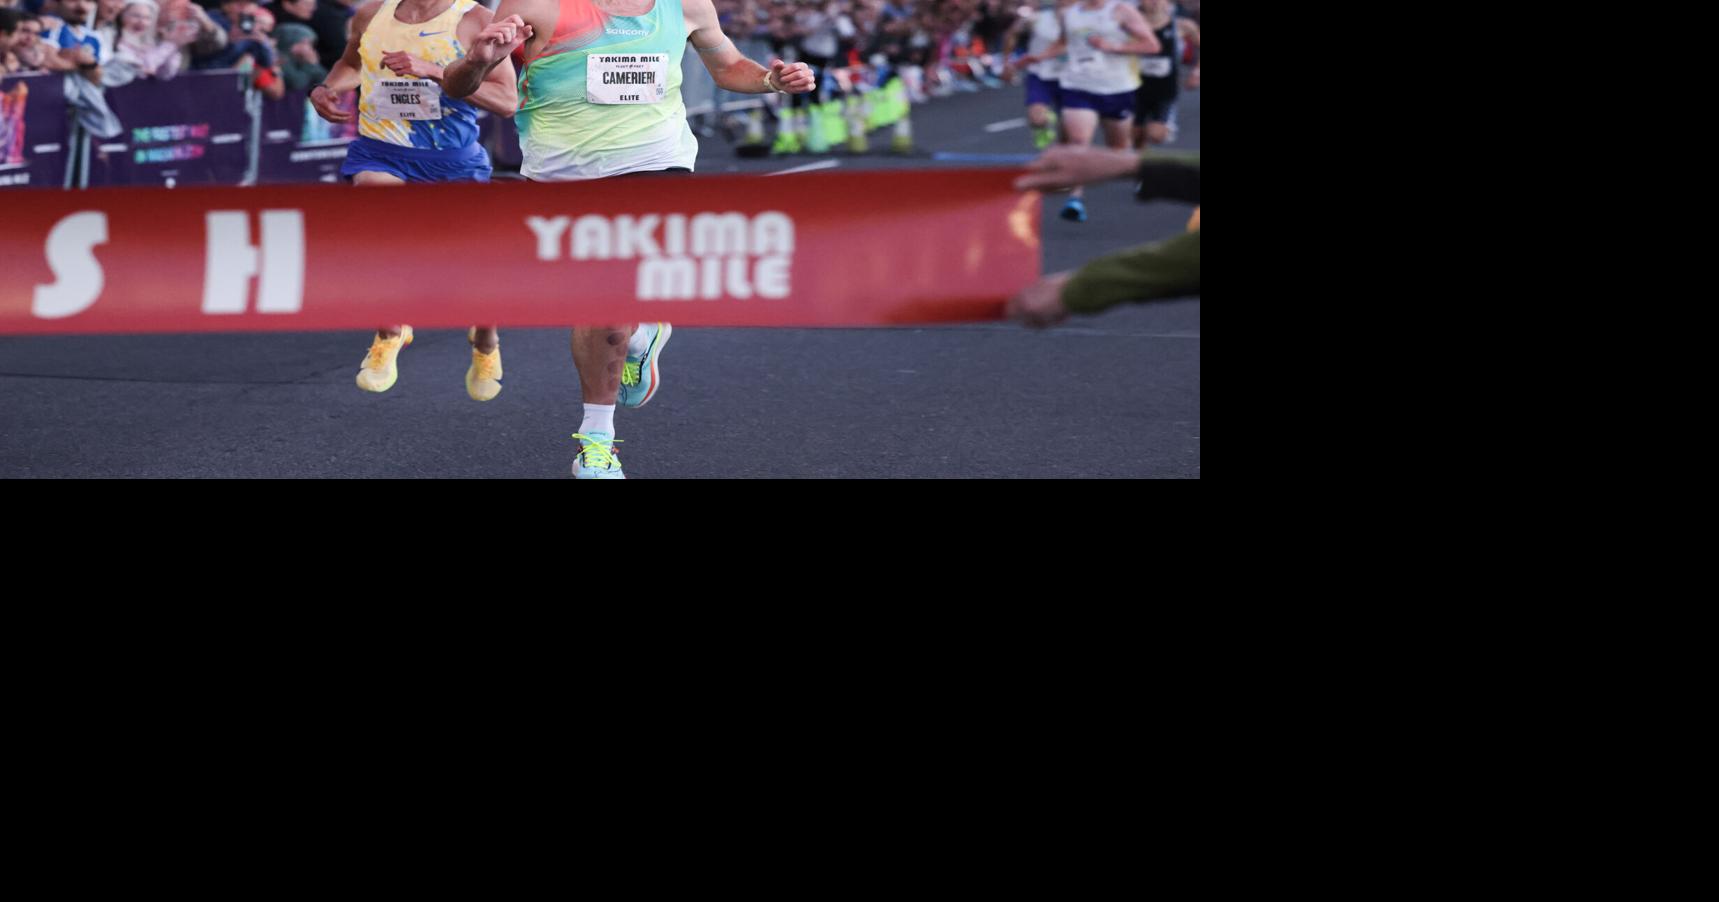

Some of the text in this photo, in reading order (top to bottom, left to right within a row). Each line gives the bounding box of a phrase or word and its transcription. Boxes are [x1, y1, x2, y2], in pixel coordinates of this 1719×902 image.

[602, 71, 655, 84] CAMERIERI
[390, 93, 421, 104] ENGLES
[526, 211, 796, 261] YAKIMA
[635, 255, 793, 300] MILE
